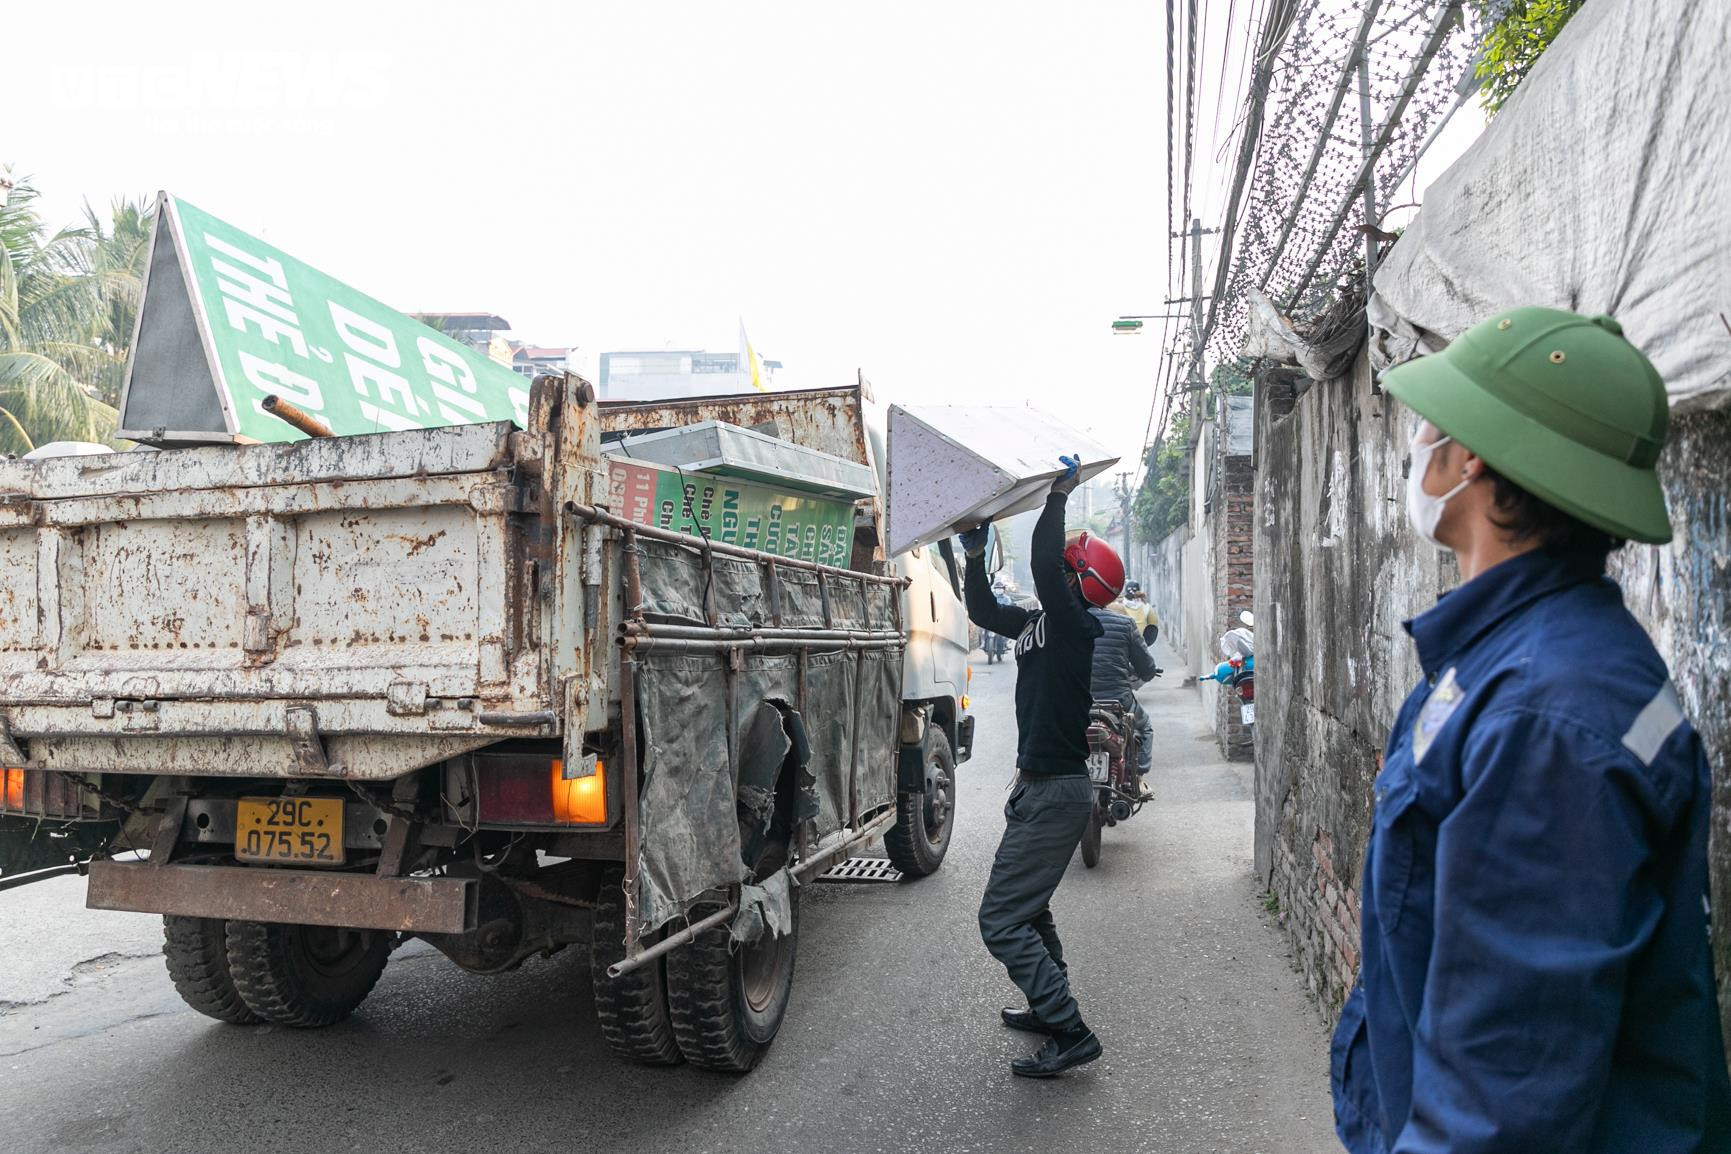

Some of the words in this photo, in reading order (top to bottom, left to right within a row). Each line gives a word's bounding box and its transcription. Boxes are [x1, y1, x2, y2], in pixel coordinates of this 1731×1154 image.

[203, 232, 334, 363] THẺ
[267, 799, 313, 827] 29C
[247, 829, 333, 860] 075.52
